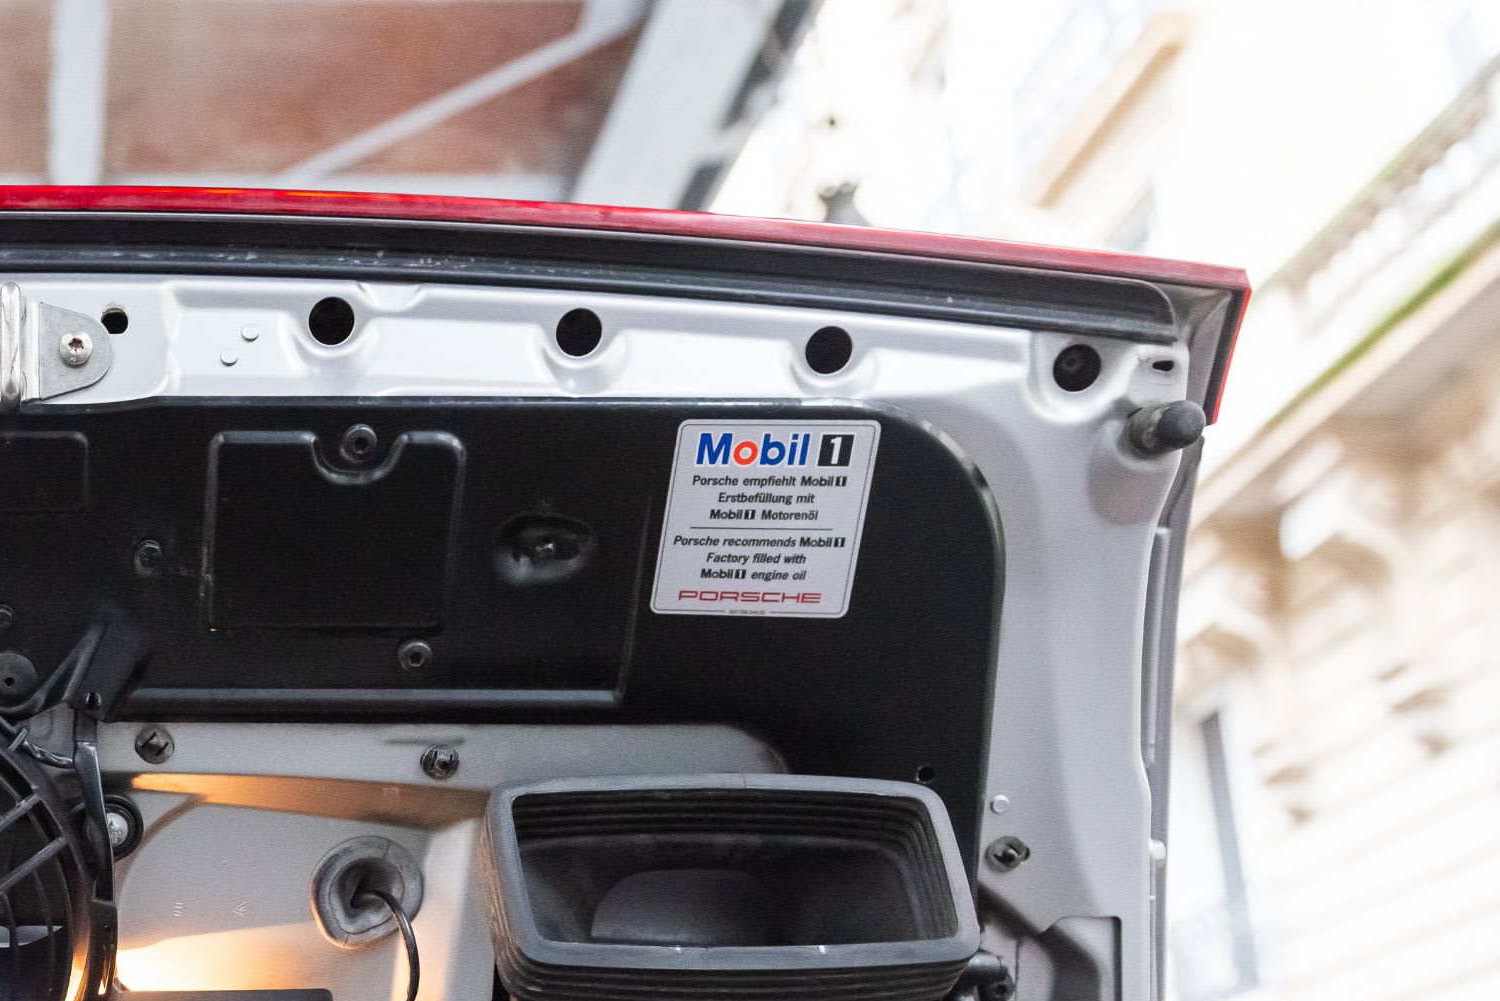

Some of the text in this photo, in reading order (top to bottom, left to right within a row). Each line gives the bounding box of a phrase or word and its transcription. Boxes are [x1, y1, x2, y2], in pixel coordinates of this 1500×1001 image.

[696, 433, 811, 466] Mobil
[692, 475, 739, 486] Porsche
[743, 476, 796, 488] empfiehlt
[718, 492, 815, 505] Erstbefüllung mit
[760, 509, 818, 521] Motorenöl
[673, 535, 719, 546] Porsche
[722, 537, 796, 547] recommends
[706, 553, 806, 565] Factory filled with
[751, 570, 788, 582] engine
[792, 570, 806, 580] oil
[678, 590, 822, 603] PORSCHE
